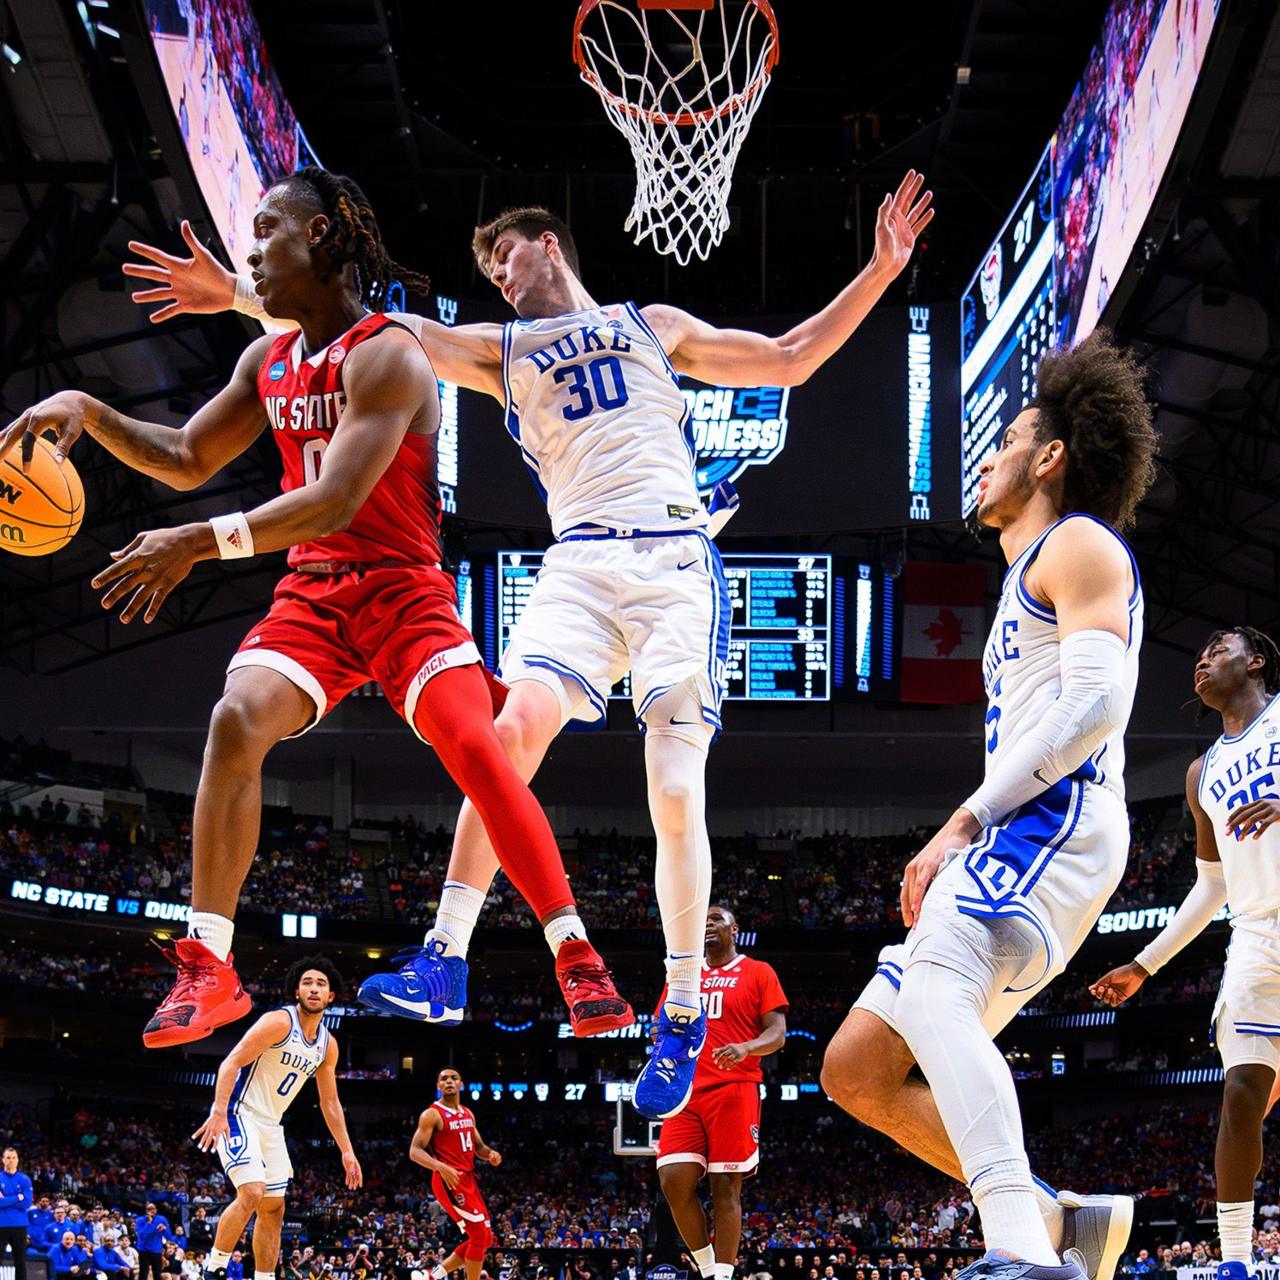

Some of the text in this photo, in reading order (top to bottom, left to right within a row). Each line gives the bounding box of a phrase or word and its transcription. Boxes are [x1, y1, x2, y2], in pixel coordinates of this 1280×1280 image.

[527, 326, 632, 375] DUKE
[553, 355, 630, 421] 30
[265, 390, 346, 431] NC STATE
[417, 653, 448, 686] PACK
[11, 880, 42, 901] NC
[44, 887, 109, 912] STATE
[116, 898, 140, 915] VS
[1097, 905, 1176, 934] SOUTH
[702, 976, 738, 989] STATE
[277, 1072, 298, 1097] 0
[564, 1084, 587, 1100] 27
[459, 1130, 473, 1152] 14
[653, 1272, 676, 1280] MARCH
